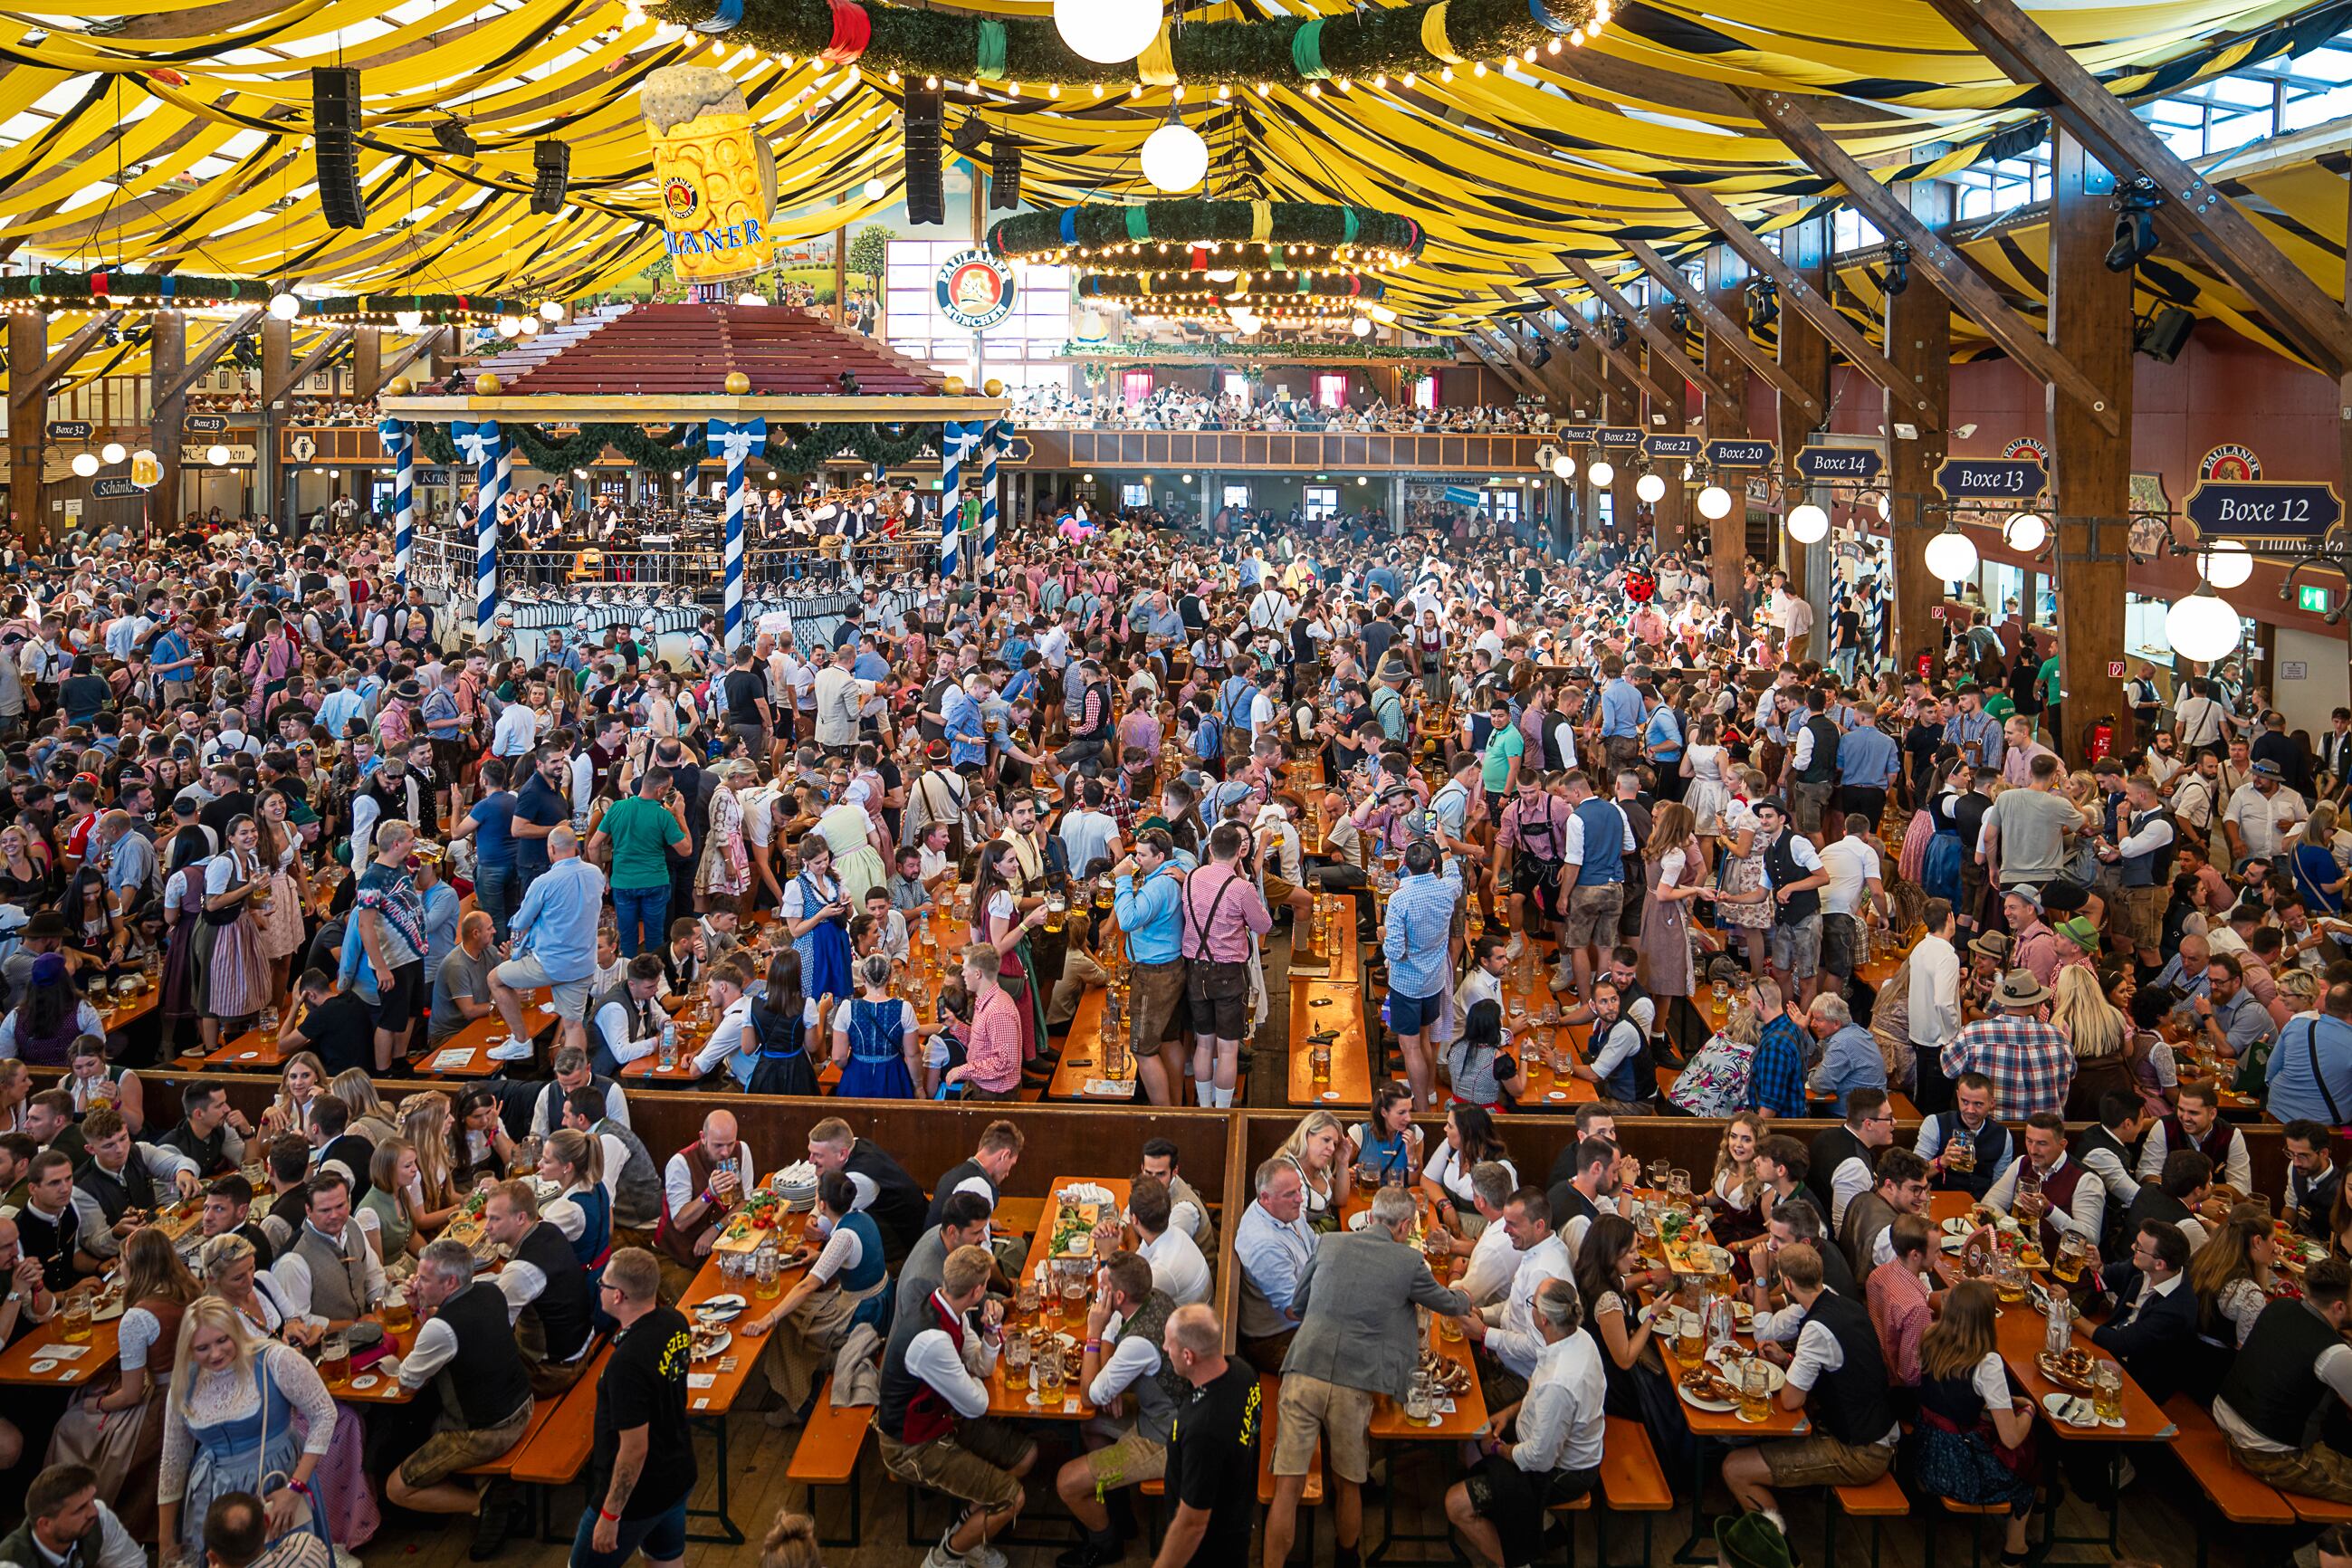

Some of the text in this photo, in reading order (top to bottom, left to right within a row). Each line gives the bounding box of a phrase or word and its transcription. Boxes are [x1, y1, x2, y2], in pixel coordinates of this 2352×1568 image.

[938, 250, 1012, 283] PAULANER
[942, 303, 1008, 327] MÜNCHEN
[55, 425, 84, 436] Boxe 32
[194, 419, 220, 430] Boxe 33
[1567, 430, 1584, 439] Boxe
[1604, 432, 1637, 442] Boxe 22
[1655, 440, 1691, 451] Boxe 21
[1719, 447, 1763, 459] Boxe 20
[2003, 439, 2049, 459] PAULANER
[1814, 455, 1866, 473] Boxe 14
[2203, 445, 2260, 473] PAULANER
[1960, 470, 2024, 492] Boxe 13
[2218, 498, 2310, 522] Boxe 12
